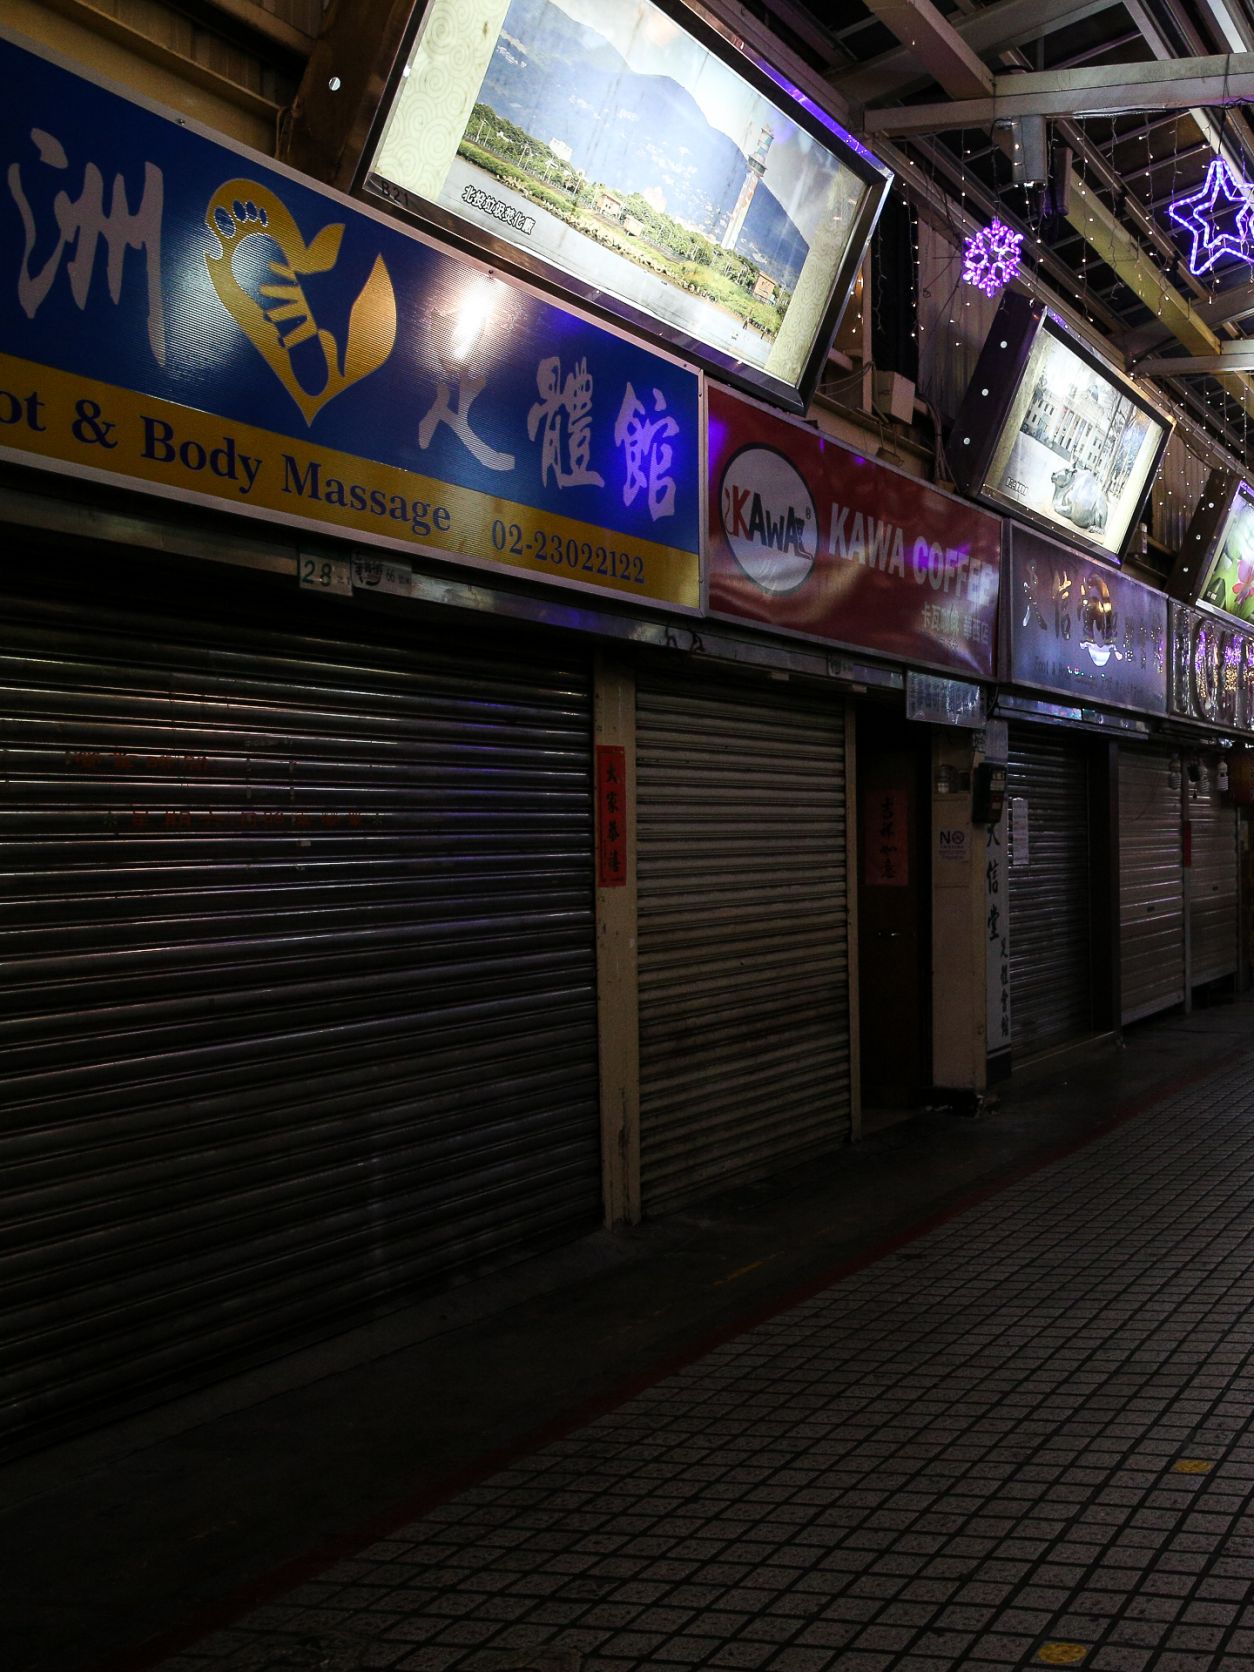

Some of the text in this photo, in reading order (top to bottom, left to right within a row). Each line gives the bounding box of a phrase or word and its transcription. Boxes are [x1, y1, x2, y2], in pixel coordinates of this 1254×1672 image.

[7, 128, 166, 367] 洲
[71, 400, 118, 449] &
[141, 416, 262, 493] Body
[282, 455, 452, 536] Massage
[491, 519, 646, 586] 02-23022122
[828, 501, 994, 607] KAWA COFFEE
